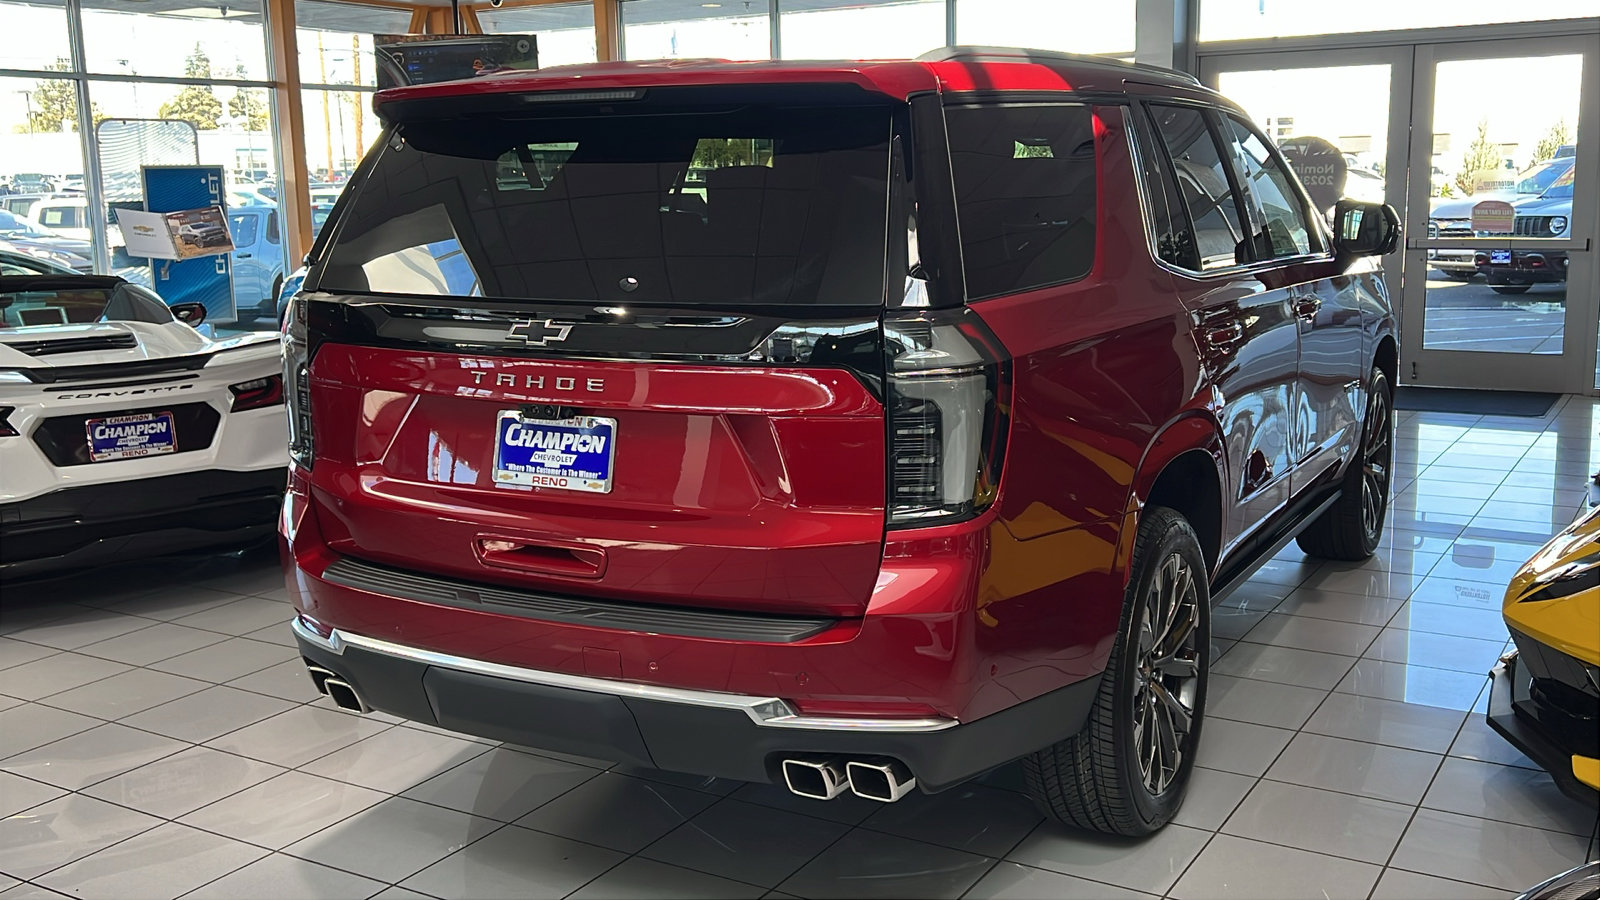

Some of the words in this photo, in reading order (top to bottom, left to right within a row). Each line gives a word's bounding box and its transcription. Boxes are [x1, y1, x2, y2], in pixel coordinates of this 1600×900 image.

[471, 371, 605, 392] TAHOE
[57, 384, 194, 400] CORVETTE
[109, 414, 150, 424] CHAMPION
[94, 422, 167, 440] CHAMPION
[505, 423, 606, 454] CHAMPION
[121, 449, 149, 457] RENO
[533, 453, 573, 463] CHEVROLET
[526, 464, 535, 472] The
[536, 466, 561, 475] Customer
[568, 469, 578, 477] The
[532, 476, 568, 487] RENO
